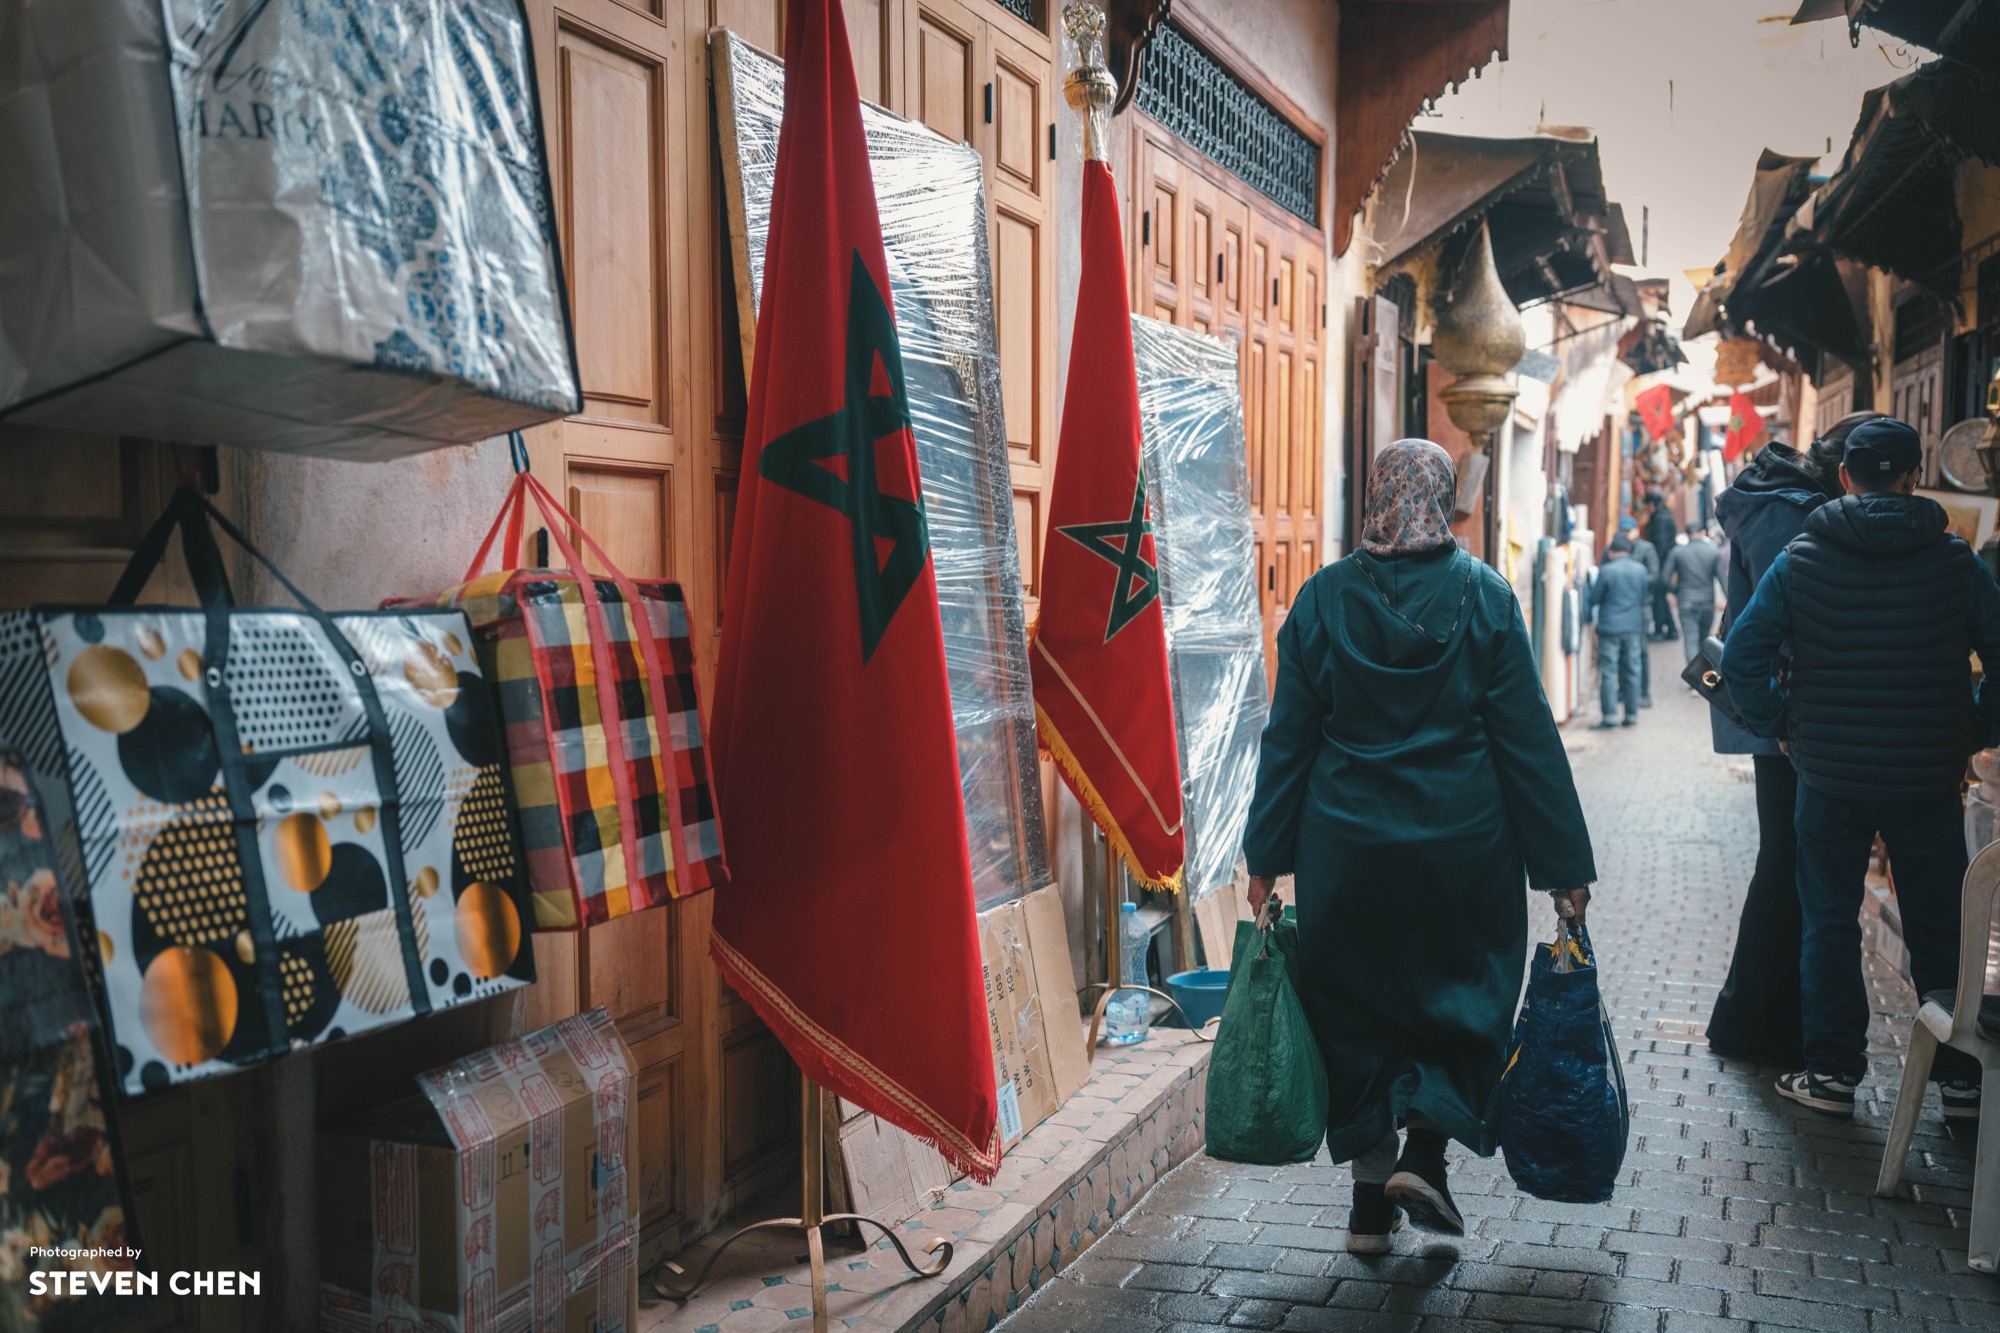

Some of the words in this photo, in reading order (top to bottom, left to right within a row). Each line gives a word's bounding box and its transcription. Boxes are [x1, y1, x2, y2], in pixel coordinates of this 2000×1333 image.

[995, 973, 1004, 1001] KGS
[1006, 966, 1015, 993] KGS
[990, 1008, 1002, 1051] BLACK
[1014, 1068, 1022, 1096] N.W.
[1023, 1060, 1033, 1088] G.W.
